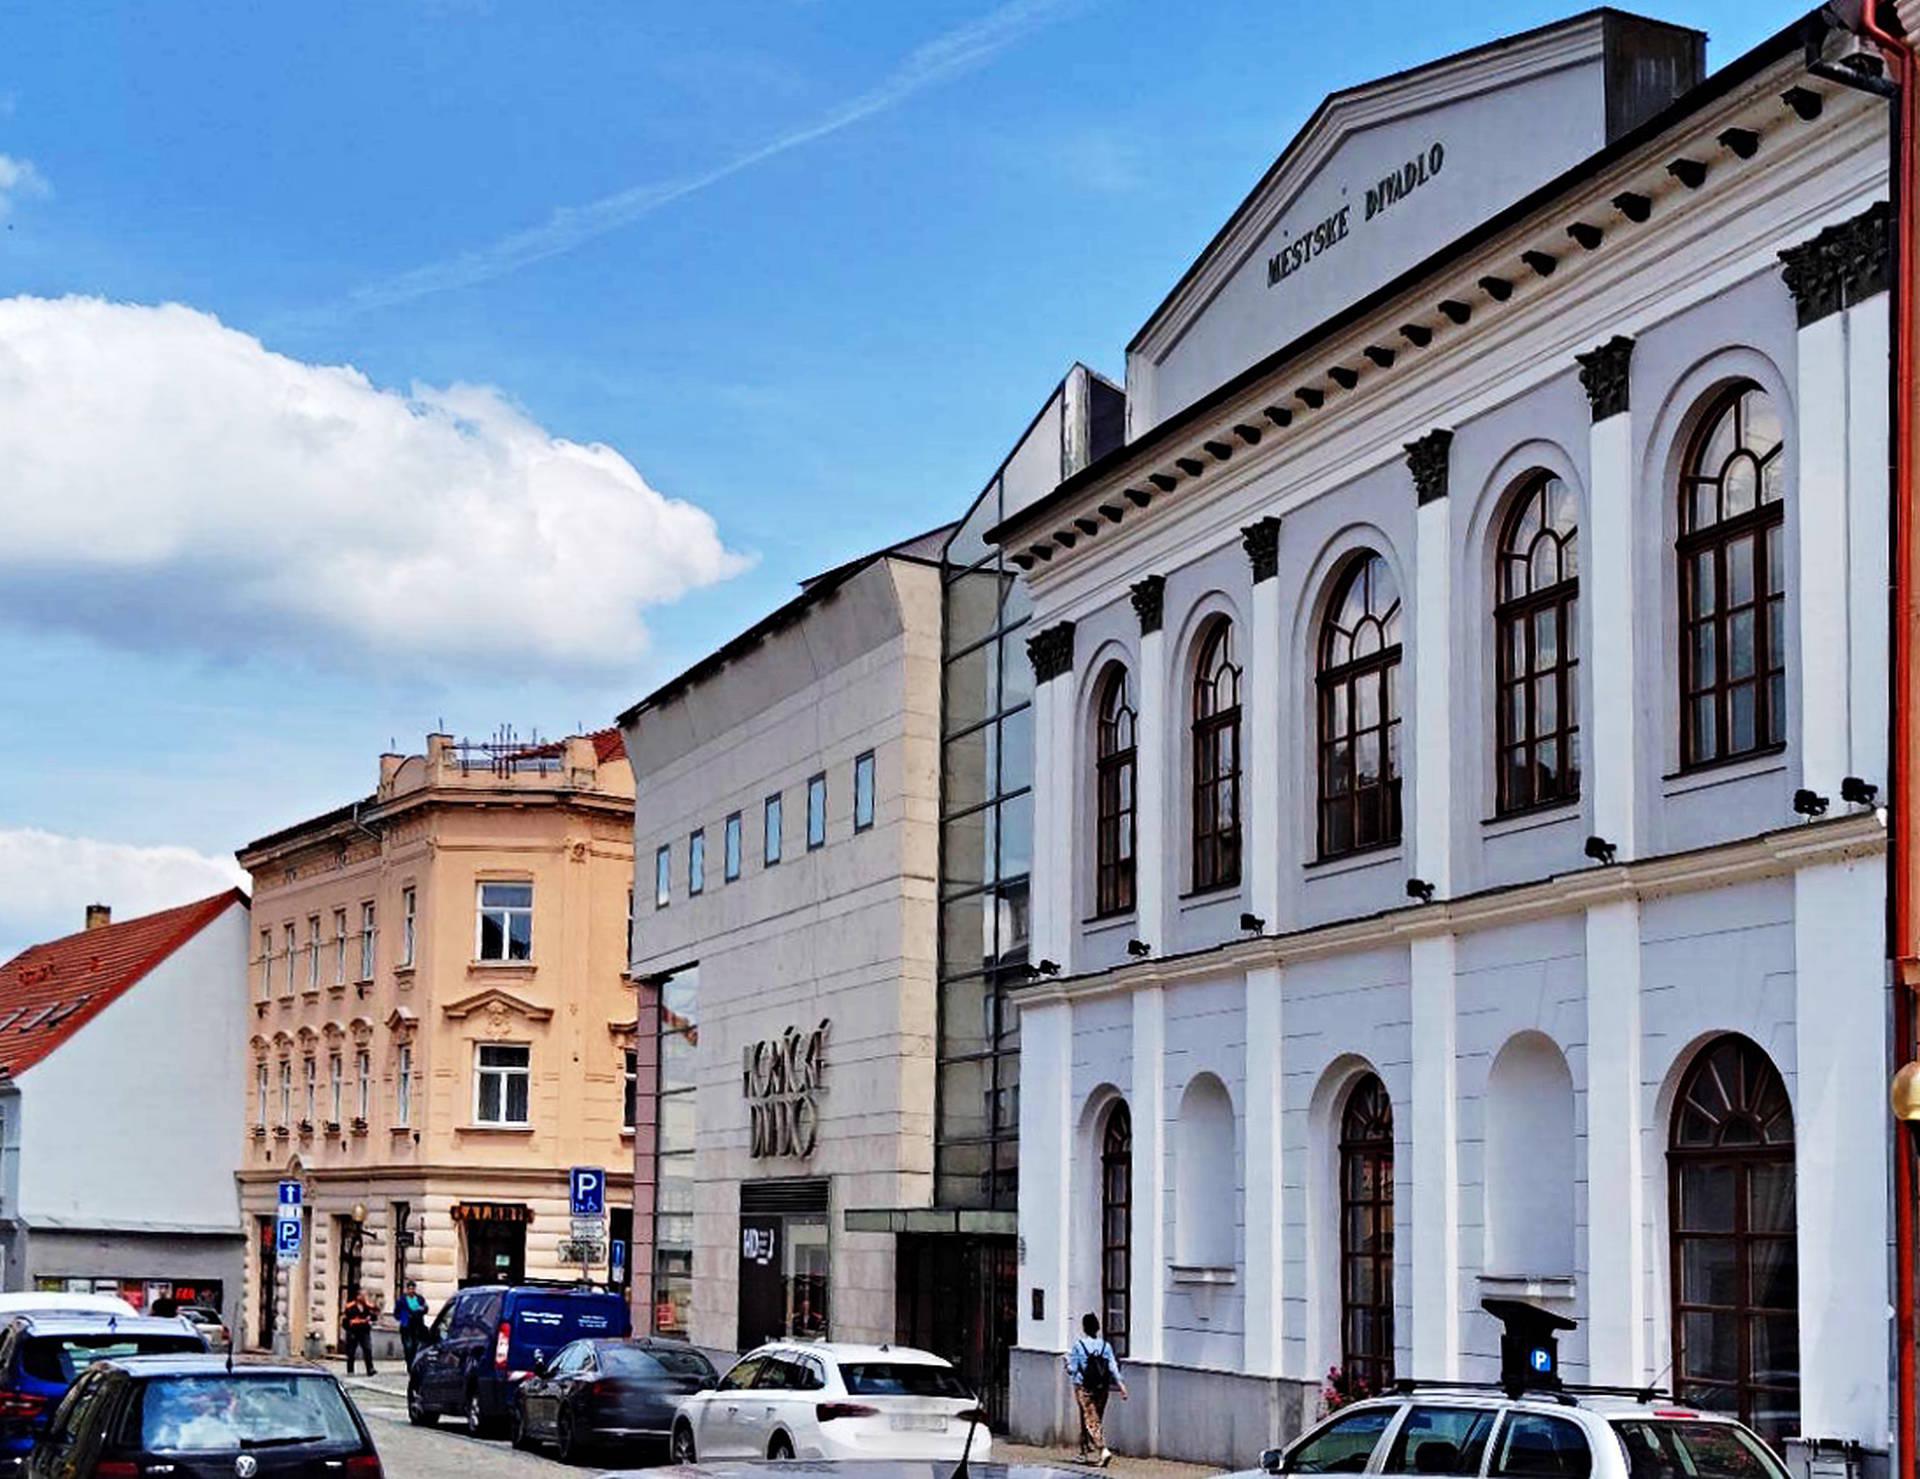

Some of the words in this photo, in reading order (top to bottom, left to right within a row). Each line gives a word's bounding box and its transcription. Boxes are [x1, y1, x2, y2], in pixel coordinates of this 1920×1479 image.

[1365, 142, 1444, 222] DIVADLO
[578, 1173, 597, 1200] P
[282, 1223, 296, 1241] P
[1536, 1350, 1547, 1370] P
